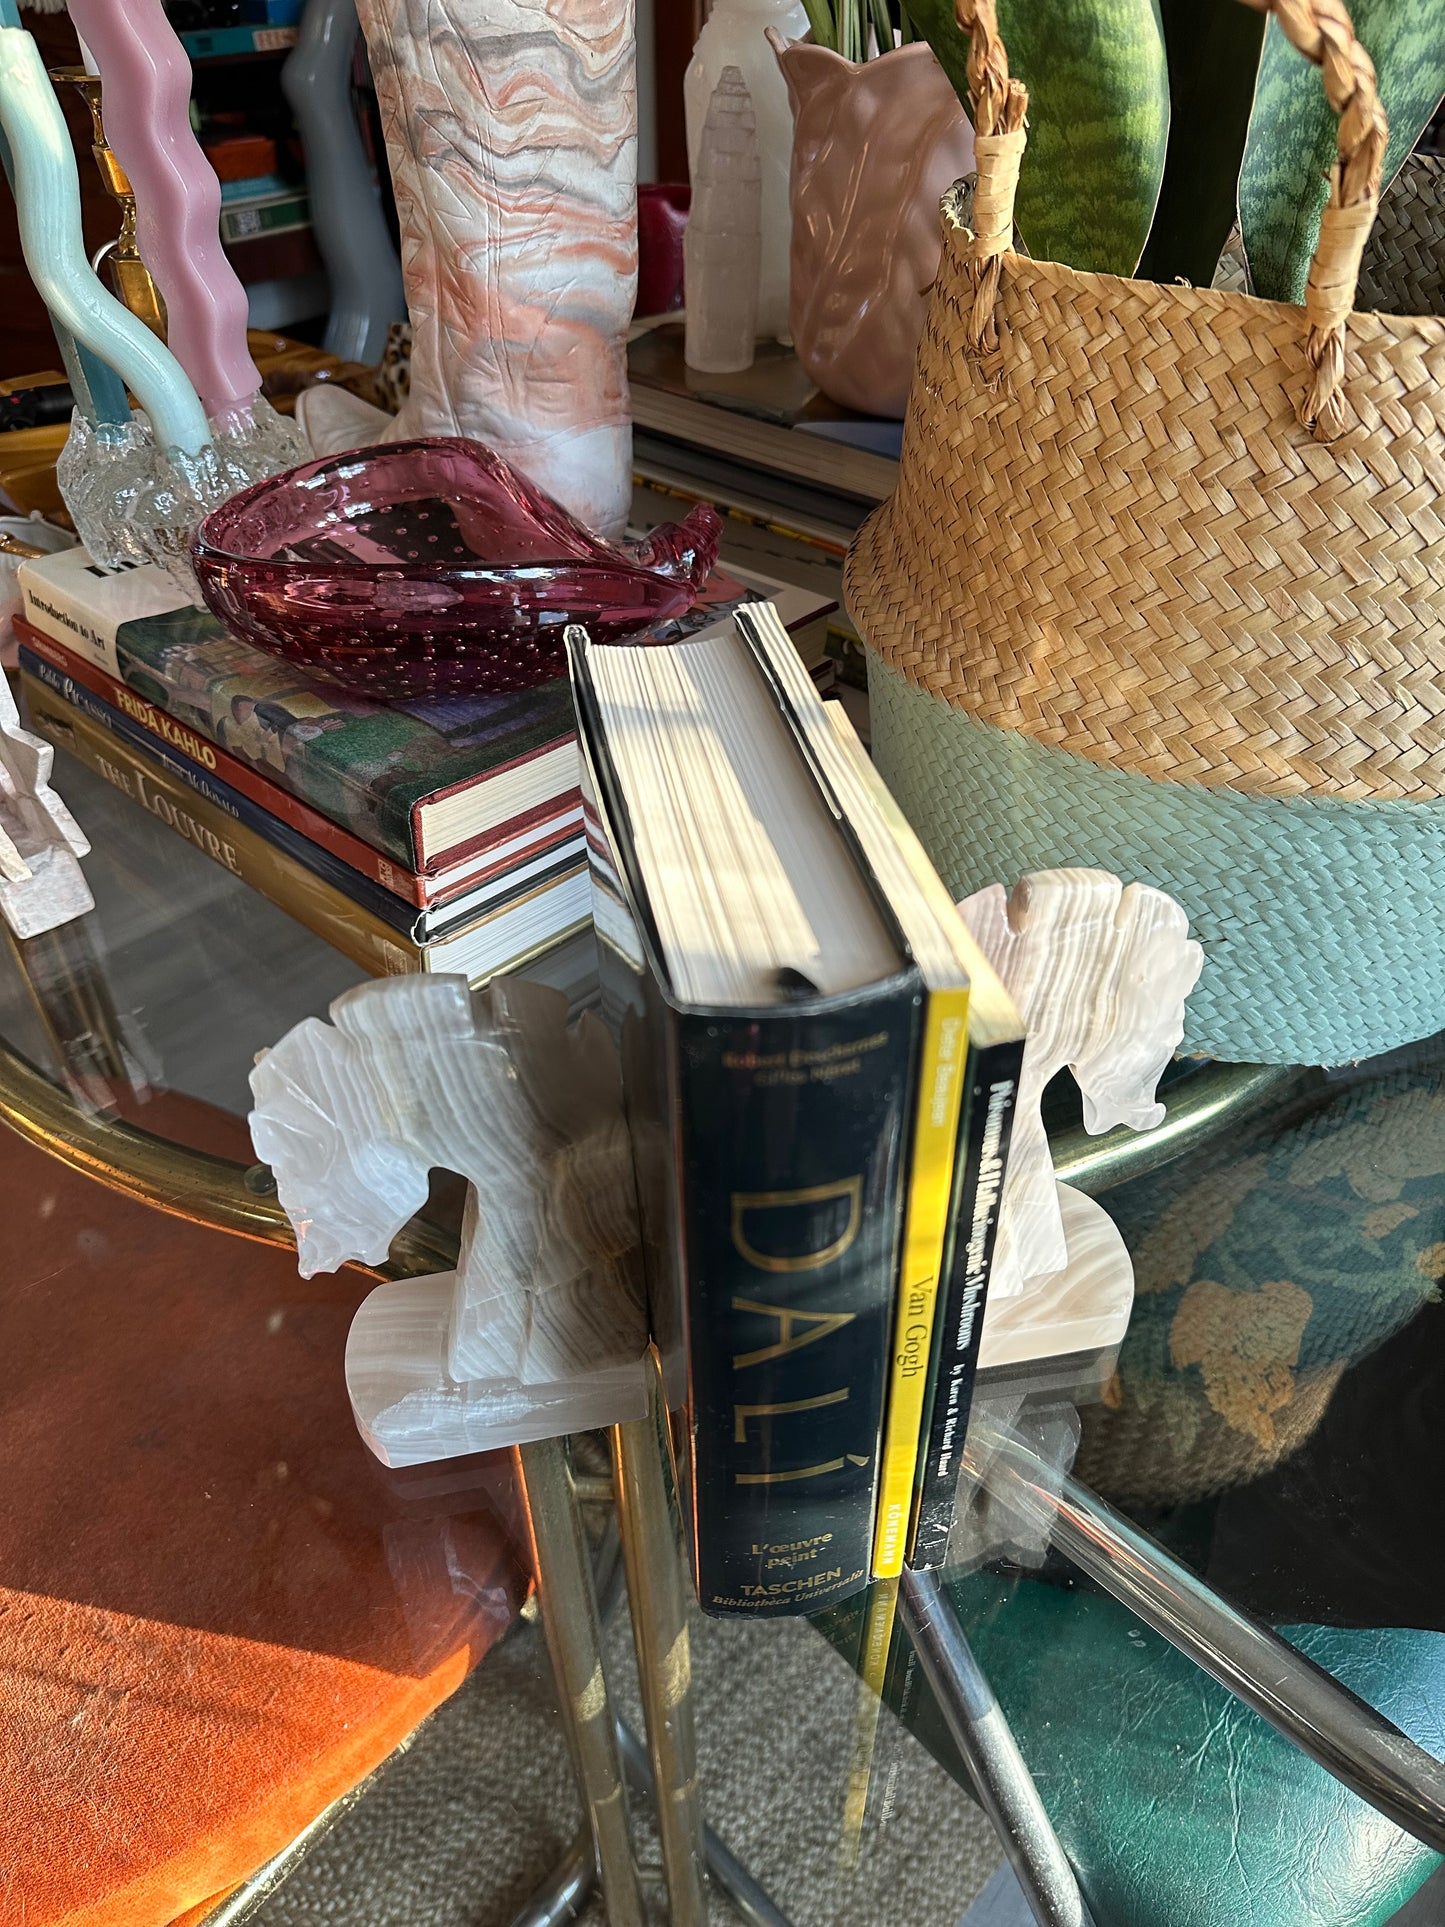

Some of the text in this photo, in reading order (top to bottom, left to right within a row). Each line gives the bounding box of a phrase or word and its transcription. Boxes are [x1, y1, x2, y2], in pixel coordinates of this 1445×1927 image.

[28, 590, 106, 650] Introduction to Art
[114, 687, 161, 731] FRIDA
[162, 720, 217, 770] KAHLO
[95, 754, 242, 876] THE LOUVRE
[955, 1079, 1015, 1351] Poisonous & Hallucinogenic Mushrooms
[896, 1275, 934, 1378] Van Gogh
[937, 1363, 965, 1477] by Karen & Richard Haard
[882, 1503, 905, 1565] KÖNEMANN
[740, 1566, 842, 1597] TASCHEN
